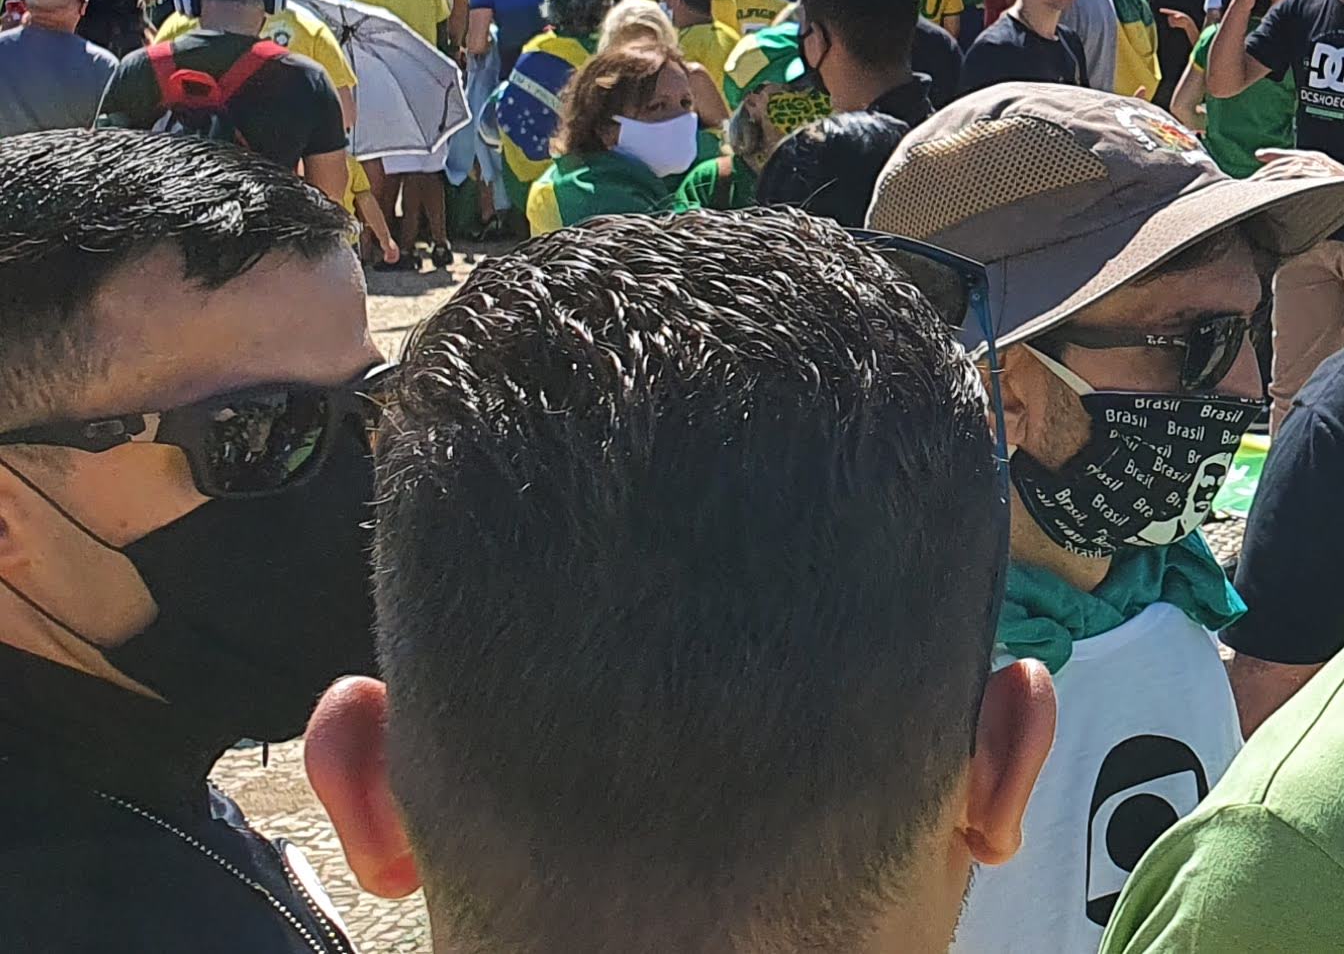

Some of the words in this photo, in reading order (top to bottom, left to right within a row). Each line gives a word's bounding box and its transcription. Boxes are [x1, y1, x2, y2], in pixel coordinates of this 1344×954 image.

[1105, 409, 1147, 428] Brasil
[1200, 404, 1244, 423] Brasil
[1167, 420, 1205, 441] Brasil
[1152, 456, 1192, 483] Brasil
[1091, 493, 1130, 526] Brasil
